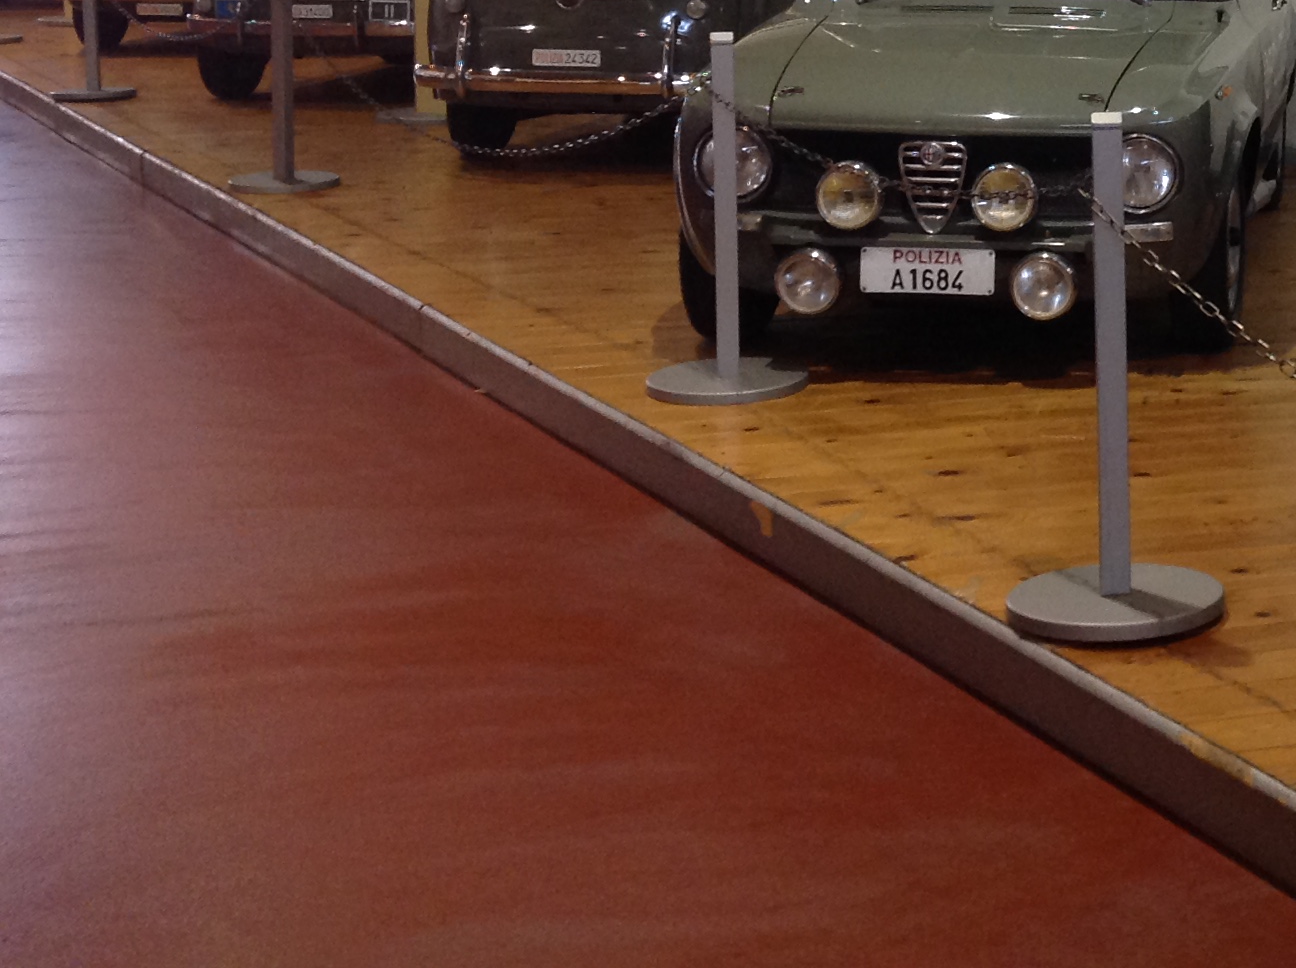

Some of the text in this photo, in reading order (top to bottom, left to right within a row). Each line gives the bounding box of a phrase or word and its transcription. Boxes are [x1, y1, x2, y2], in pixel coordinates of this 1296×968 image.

[564, 53, 598, 65] 24342
[893, 249, 962, 264] POLIZIA
[891, 268, 963, 291] A1684
